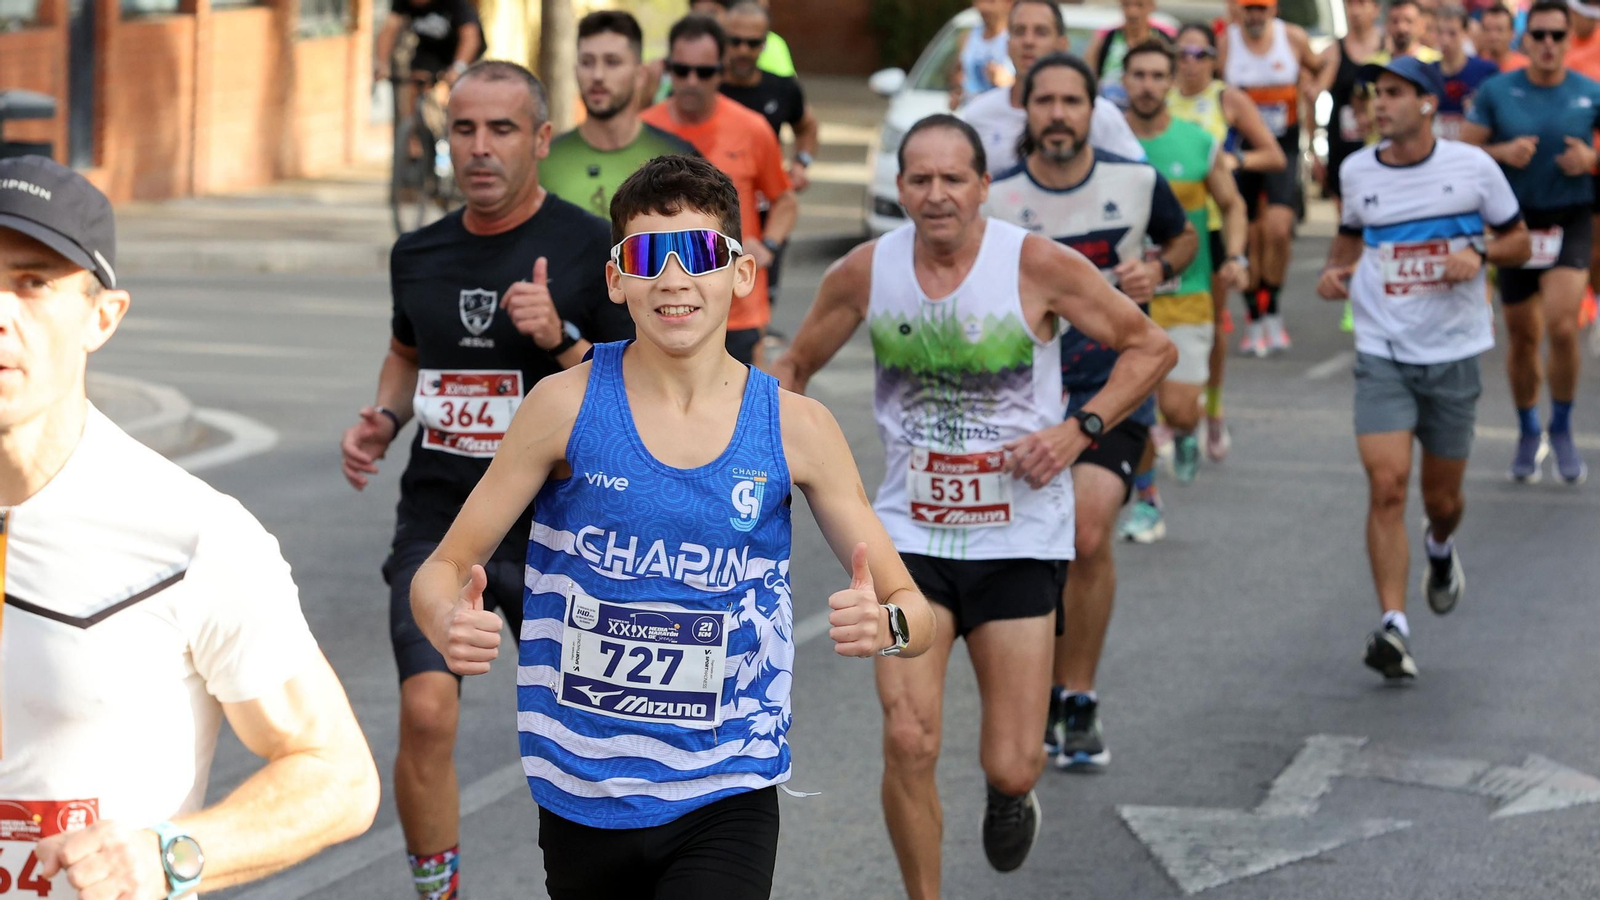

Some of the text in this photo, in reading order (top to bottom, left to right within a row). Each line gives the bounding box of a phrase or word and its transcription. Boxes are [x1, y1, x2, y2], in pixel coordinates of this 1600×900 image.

[0, 178, 51, 201] IPRUN
[440, 401, 494, 427] 364
[585, 471, 629, 491] vive
[732, 467, 768, 477] CHAPIN
[931, 477, 981, 502] 531
[576, 525, 749, 587] CHAPIN
[699, 622, 713, 632] 21
[600, 640, 684, 685] 727
